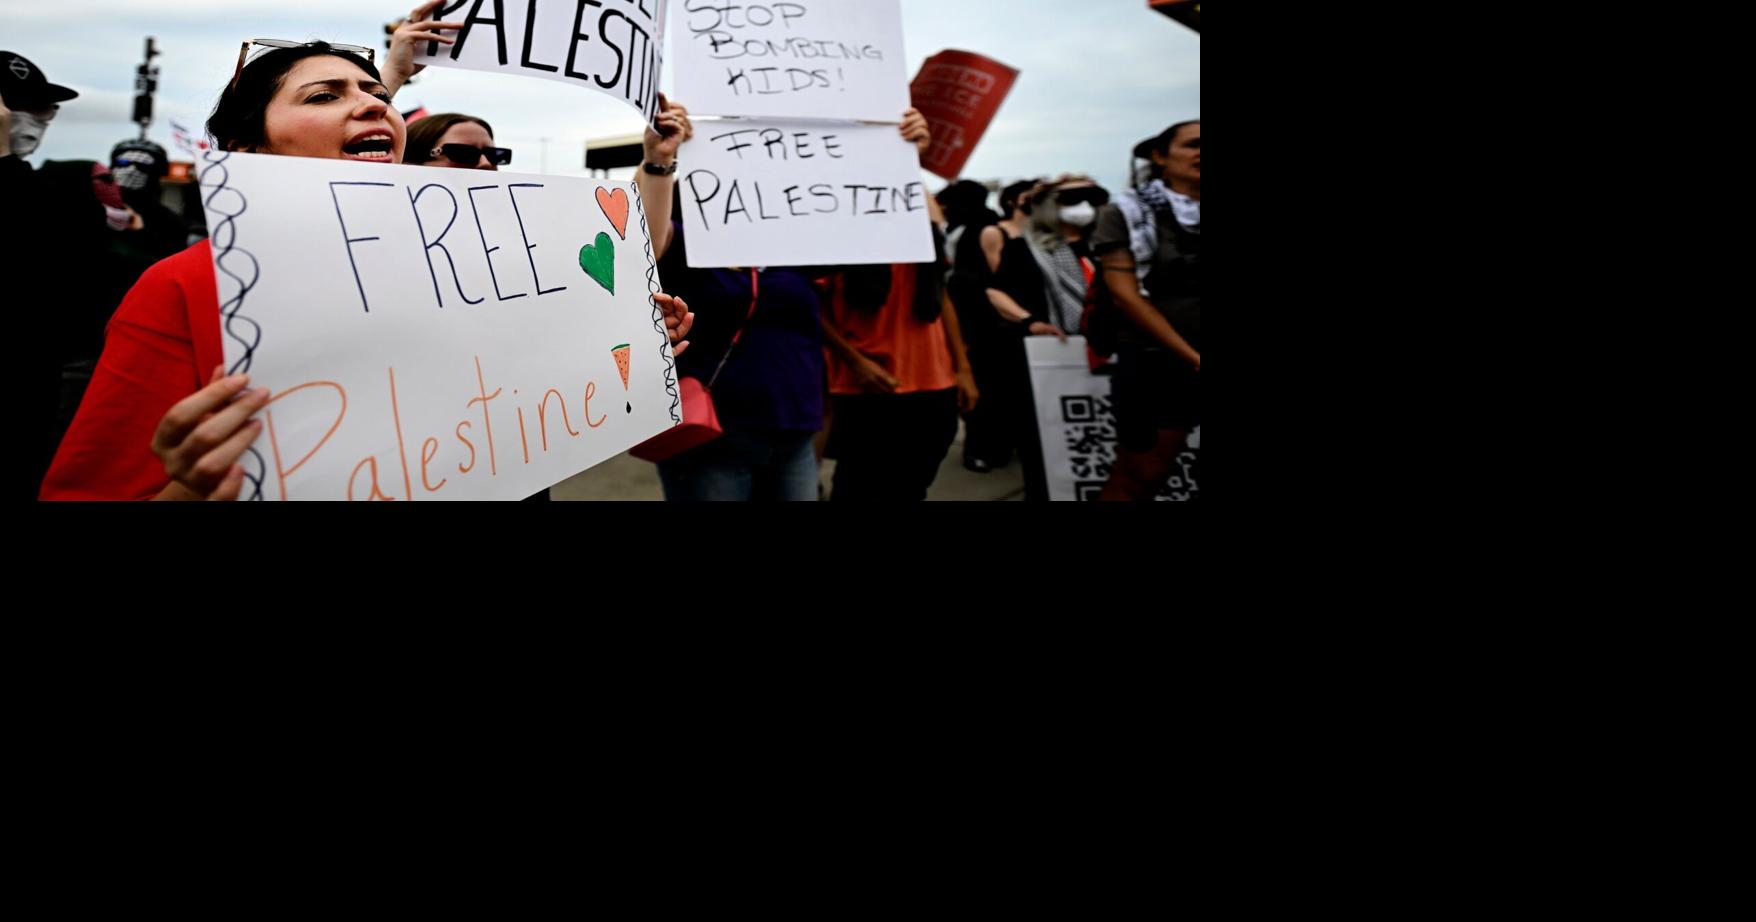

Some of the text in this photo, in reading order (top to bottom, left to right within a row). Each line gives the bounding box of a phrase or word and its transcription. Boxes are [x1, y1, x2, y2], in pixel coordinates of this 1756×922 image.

[427, 0, 659, 123] PALESTIN
[693, 30, 883, 60] BOMBING
[726, 67, 845, 96] KIDS!
[710, 128, 845, 160] FREE
[685, 169, 924, 230] PALESTINE
[329, 180, 567, 312] FREE
